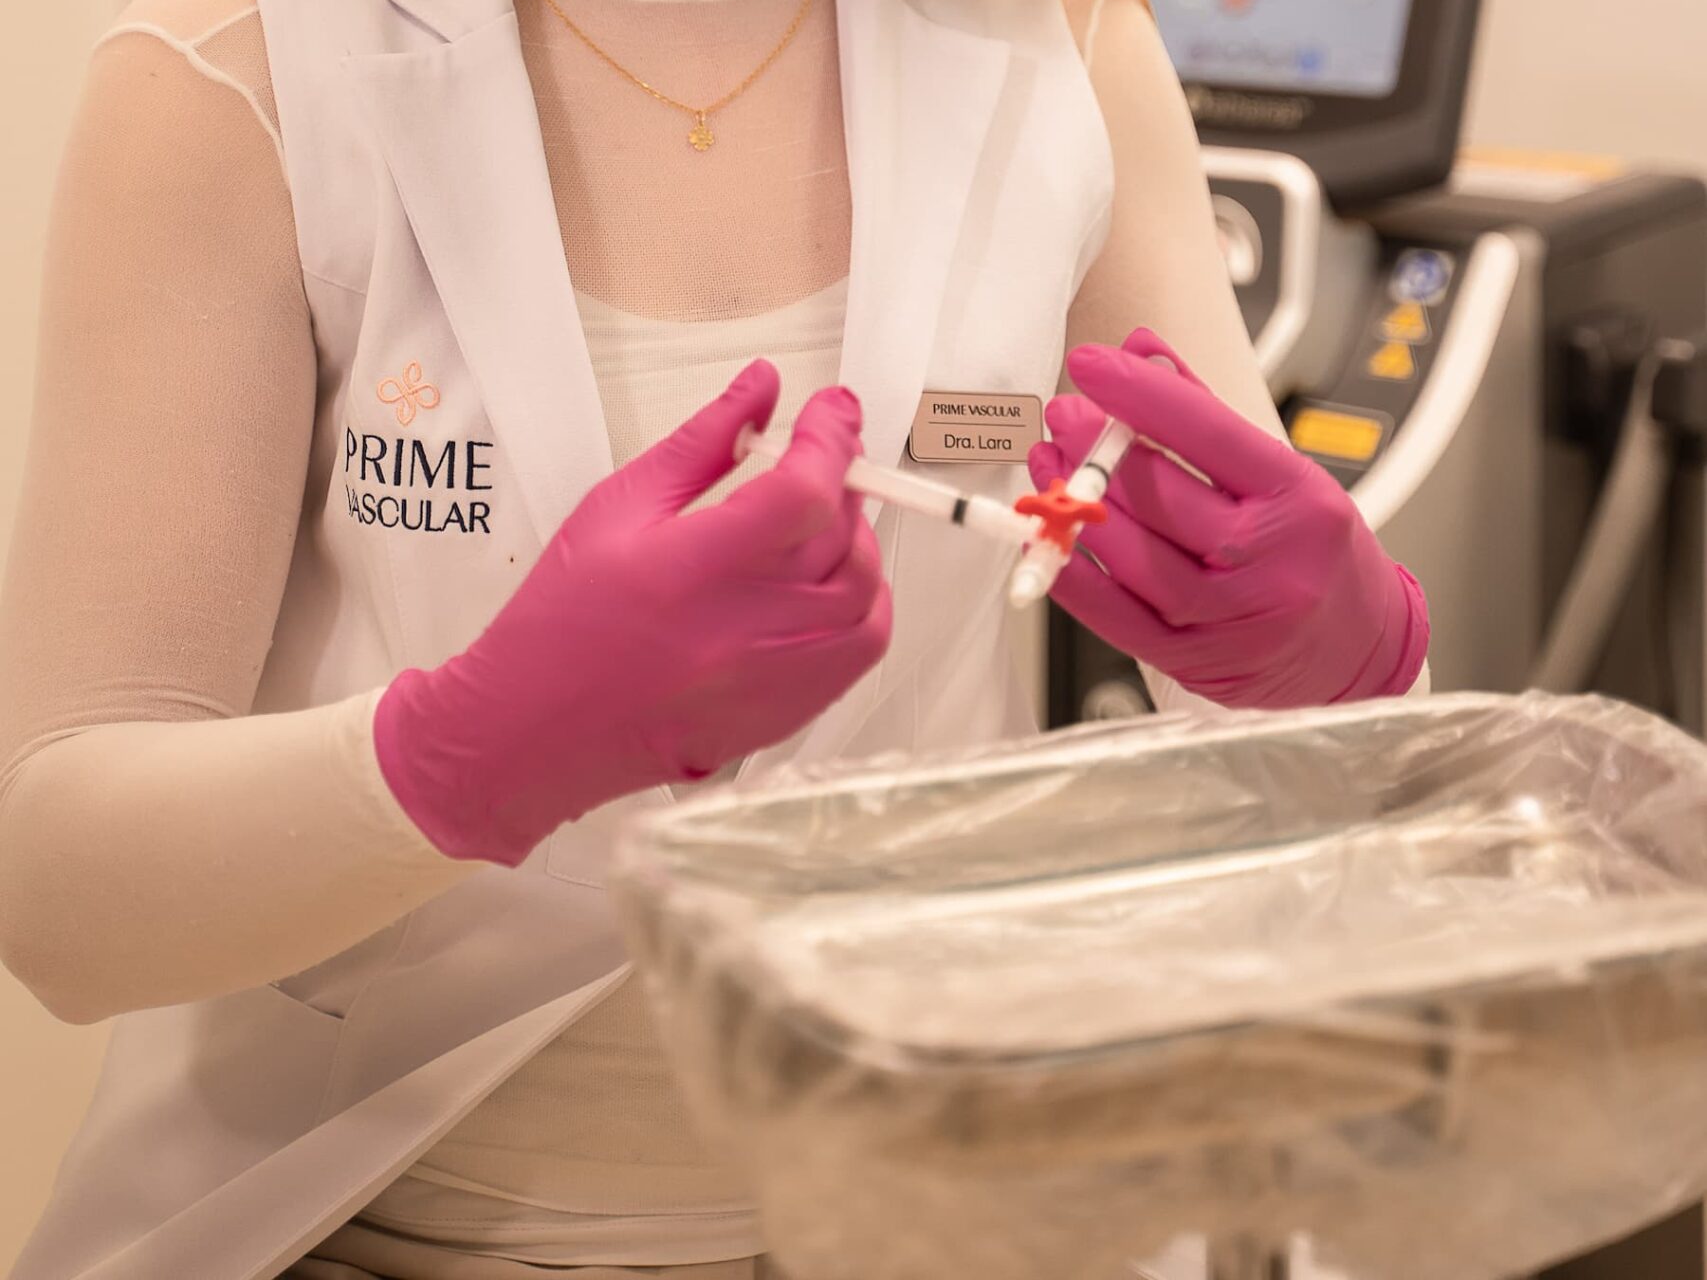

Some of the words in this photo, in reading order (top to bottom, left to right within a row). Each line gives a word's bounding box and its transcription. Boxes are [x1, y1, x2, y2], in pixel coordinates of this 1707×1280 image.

[933, 403, 967, 415] PRIME
[968, 405, 1021, 417] VASCULAR
[345, 426, 494, 490] PRIME
[944, 433, 975, 449] Dra.
[978, 435, 1012, 451] Lara
[345, 484, 491, 534] VASCULAR
